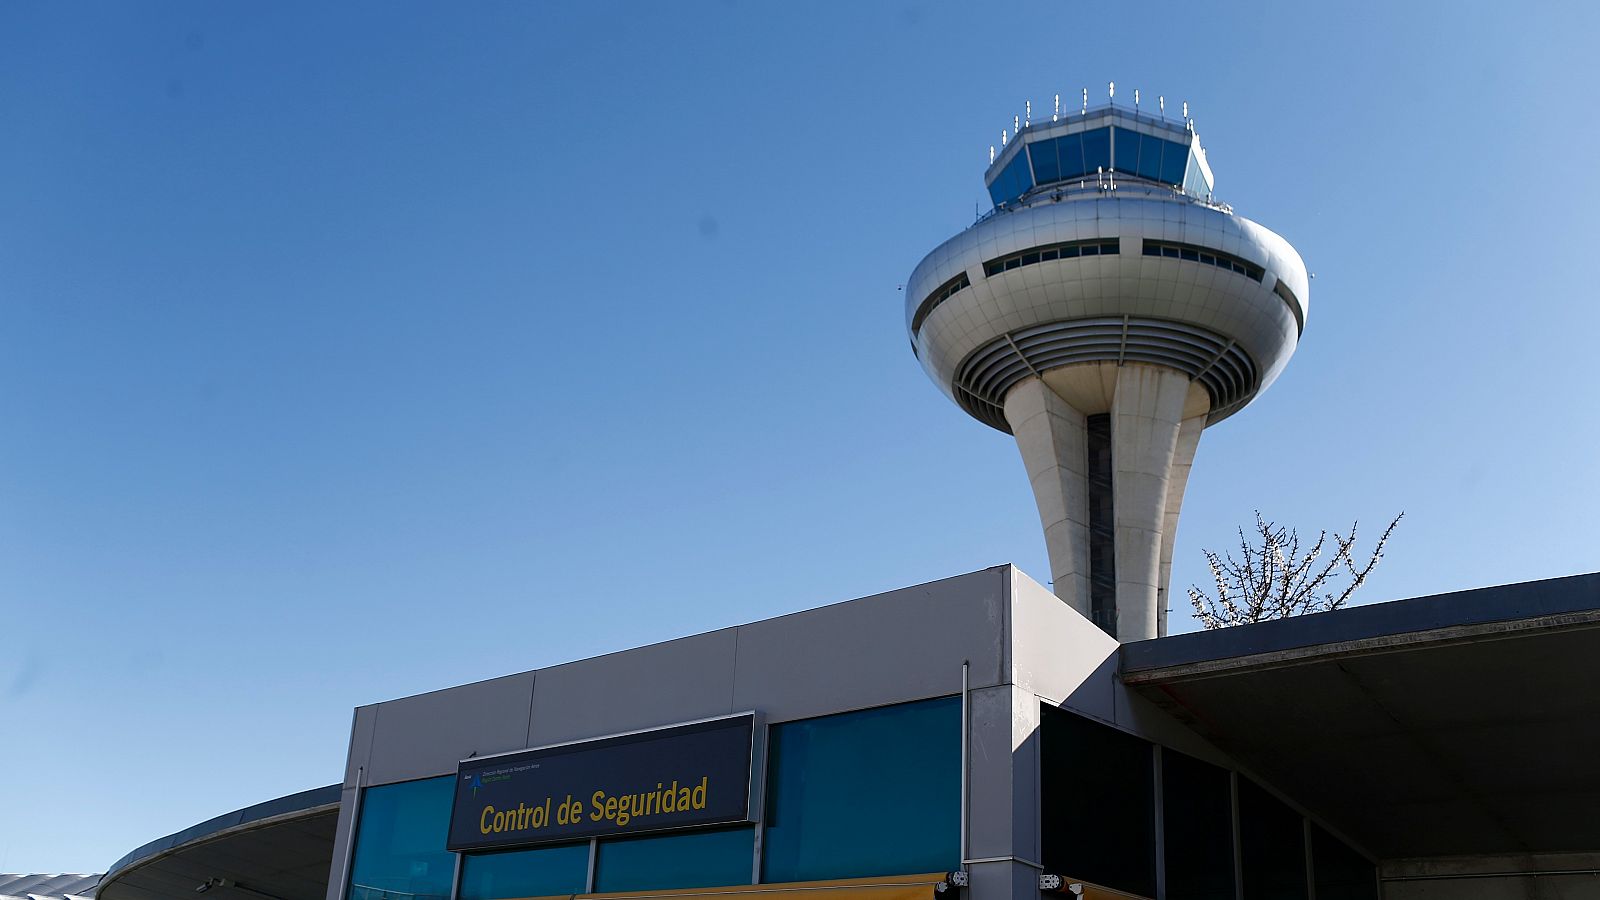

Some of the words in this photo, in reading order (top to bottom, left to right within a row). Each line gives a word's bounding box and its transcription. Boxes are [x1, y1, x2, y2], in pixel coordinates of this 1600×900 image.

[480, 798, 551, 834] Control
[556, 795, 583, 825] de
[589, 776, 708, 826] Seguridad
